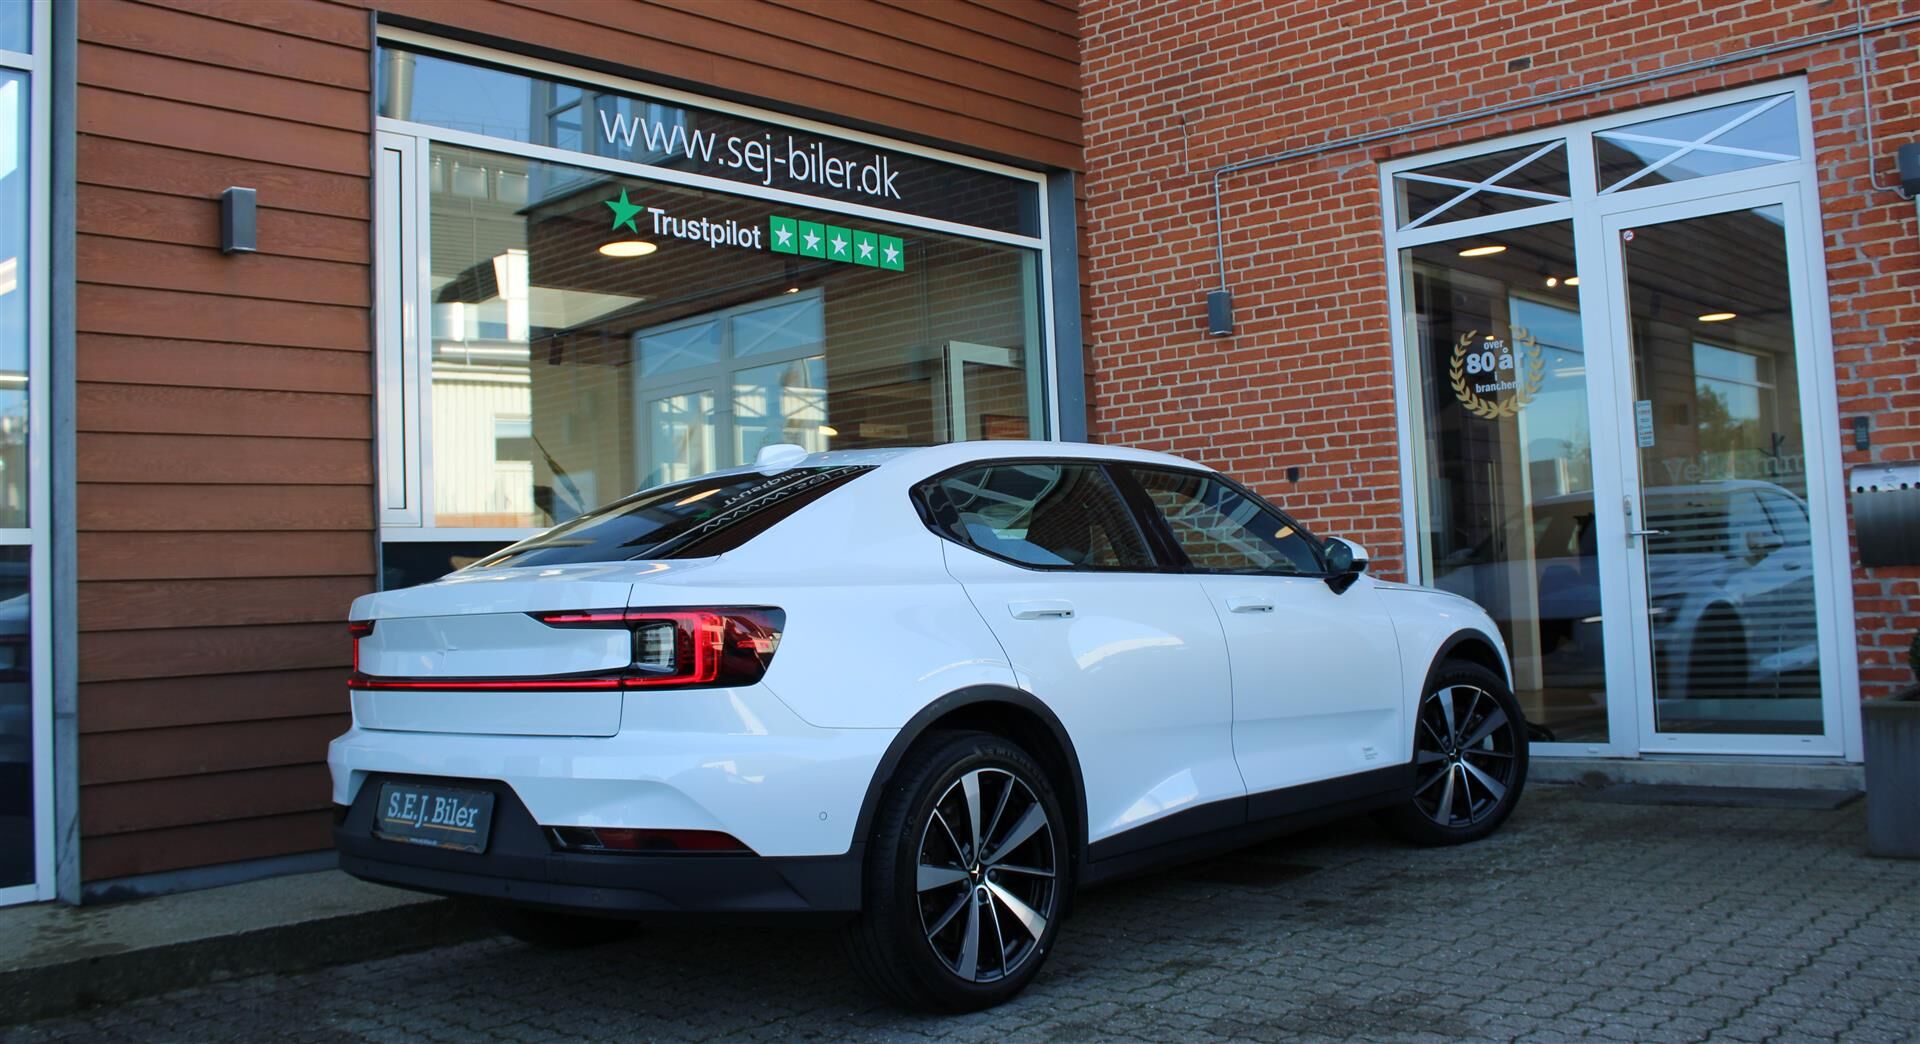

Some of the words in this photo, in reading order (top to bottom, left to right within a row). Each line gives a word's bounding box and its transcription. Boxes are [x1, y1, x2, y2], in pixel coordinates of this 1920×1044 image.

[600, 109, 901, 199] www.sej-biler.dk
[648, 207, 762, 249] Trustpilot
[1466, 351, 1495, 374] 80
[1483, 340, 1504, 350] over
[387, 791, 428, 828] S.E.J.
[431, 796, 479, 828] Biler
